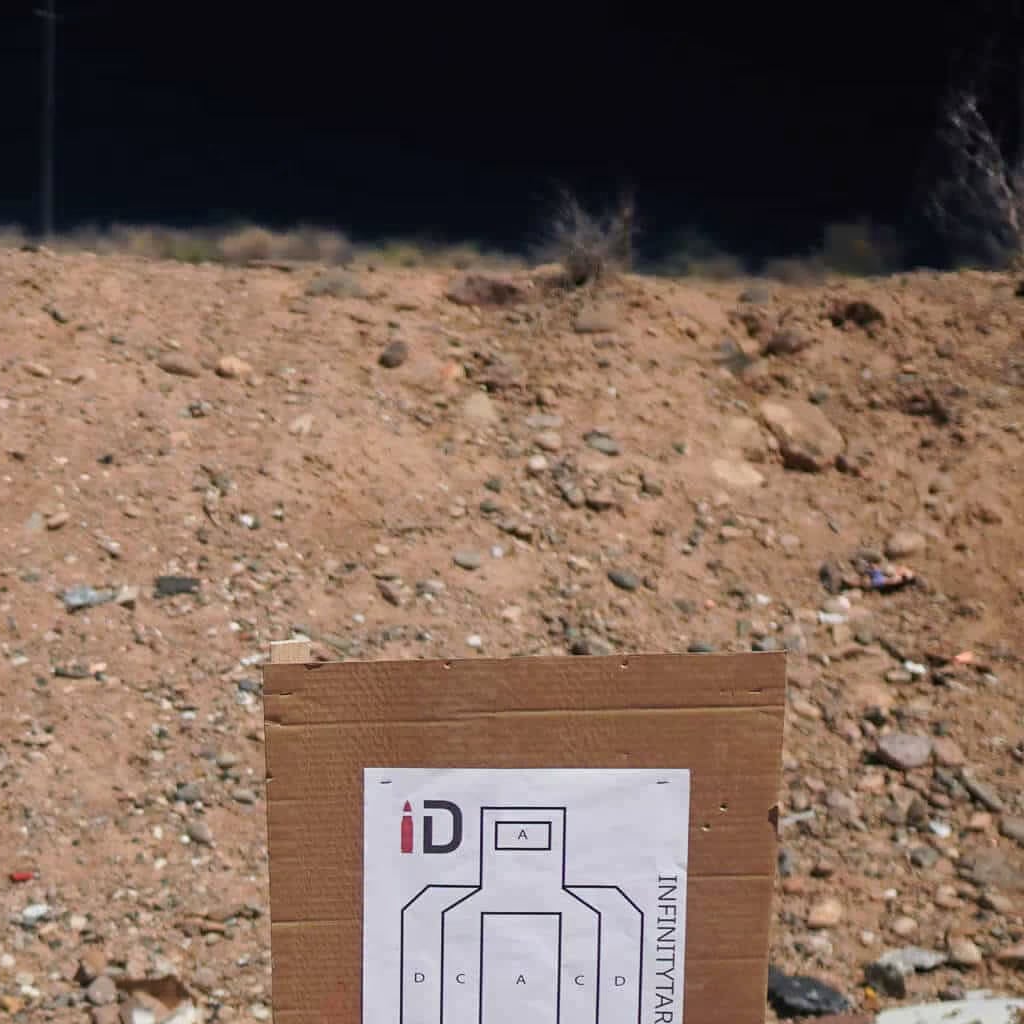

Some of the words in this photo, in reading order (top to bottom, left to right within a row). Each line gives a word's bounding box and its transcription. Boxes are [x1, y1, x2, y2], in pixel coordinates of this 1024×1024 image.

[517, 828, 529, 841] A
[413, 971, 426, 984] D
[455, 973, 466, 985] C
[515, 974, 527, 985] A
[574, 974, 585, 986] C
[614, 975, 627, 987] D
